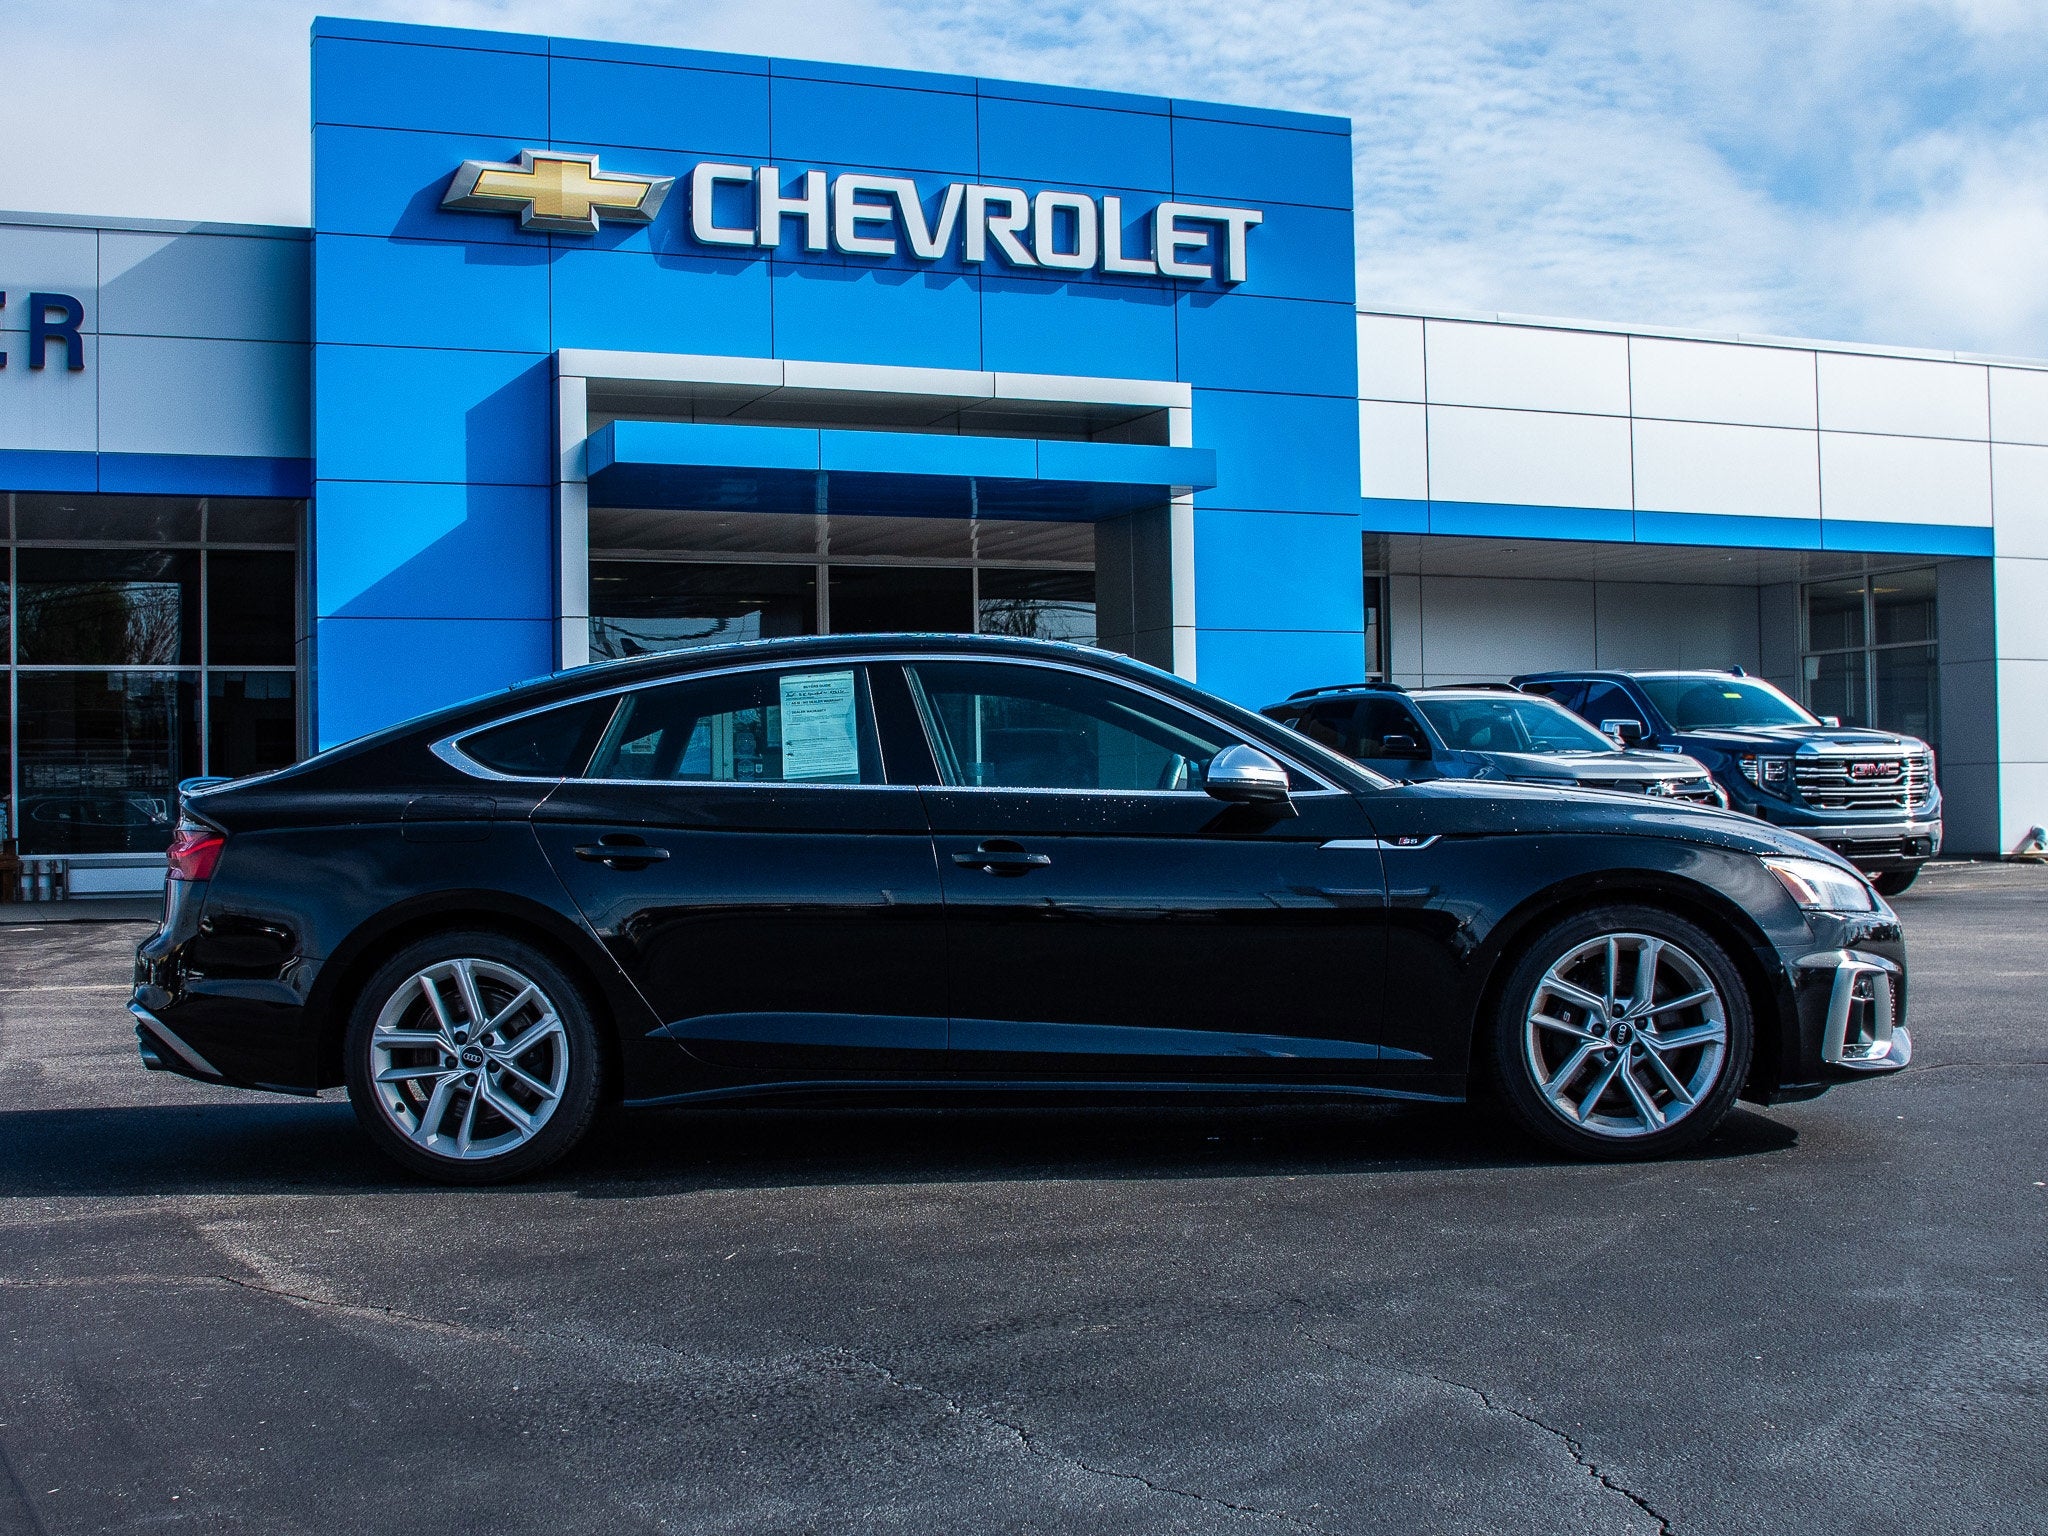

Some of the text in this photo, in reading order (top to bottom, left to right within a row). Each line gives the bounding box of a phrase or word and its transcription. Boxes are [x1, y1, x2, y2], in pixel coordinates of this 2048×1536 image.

[690, 162, 1263, 283] CHEVROLET
[0, 290, 85, 371] R
[1852, 763, 1899, 776] GMC
